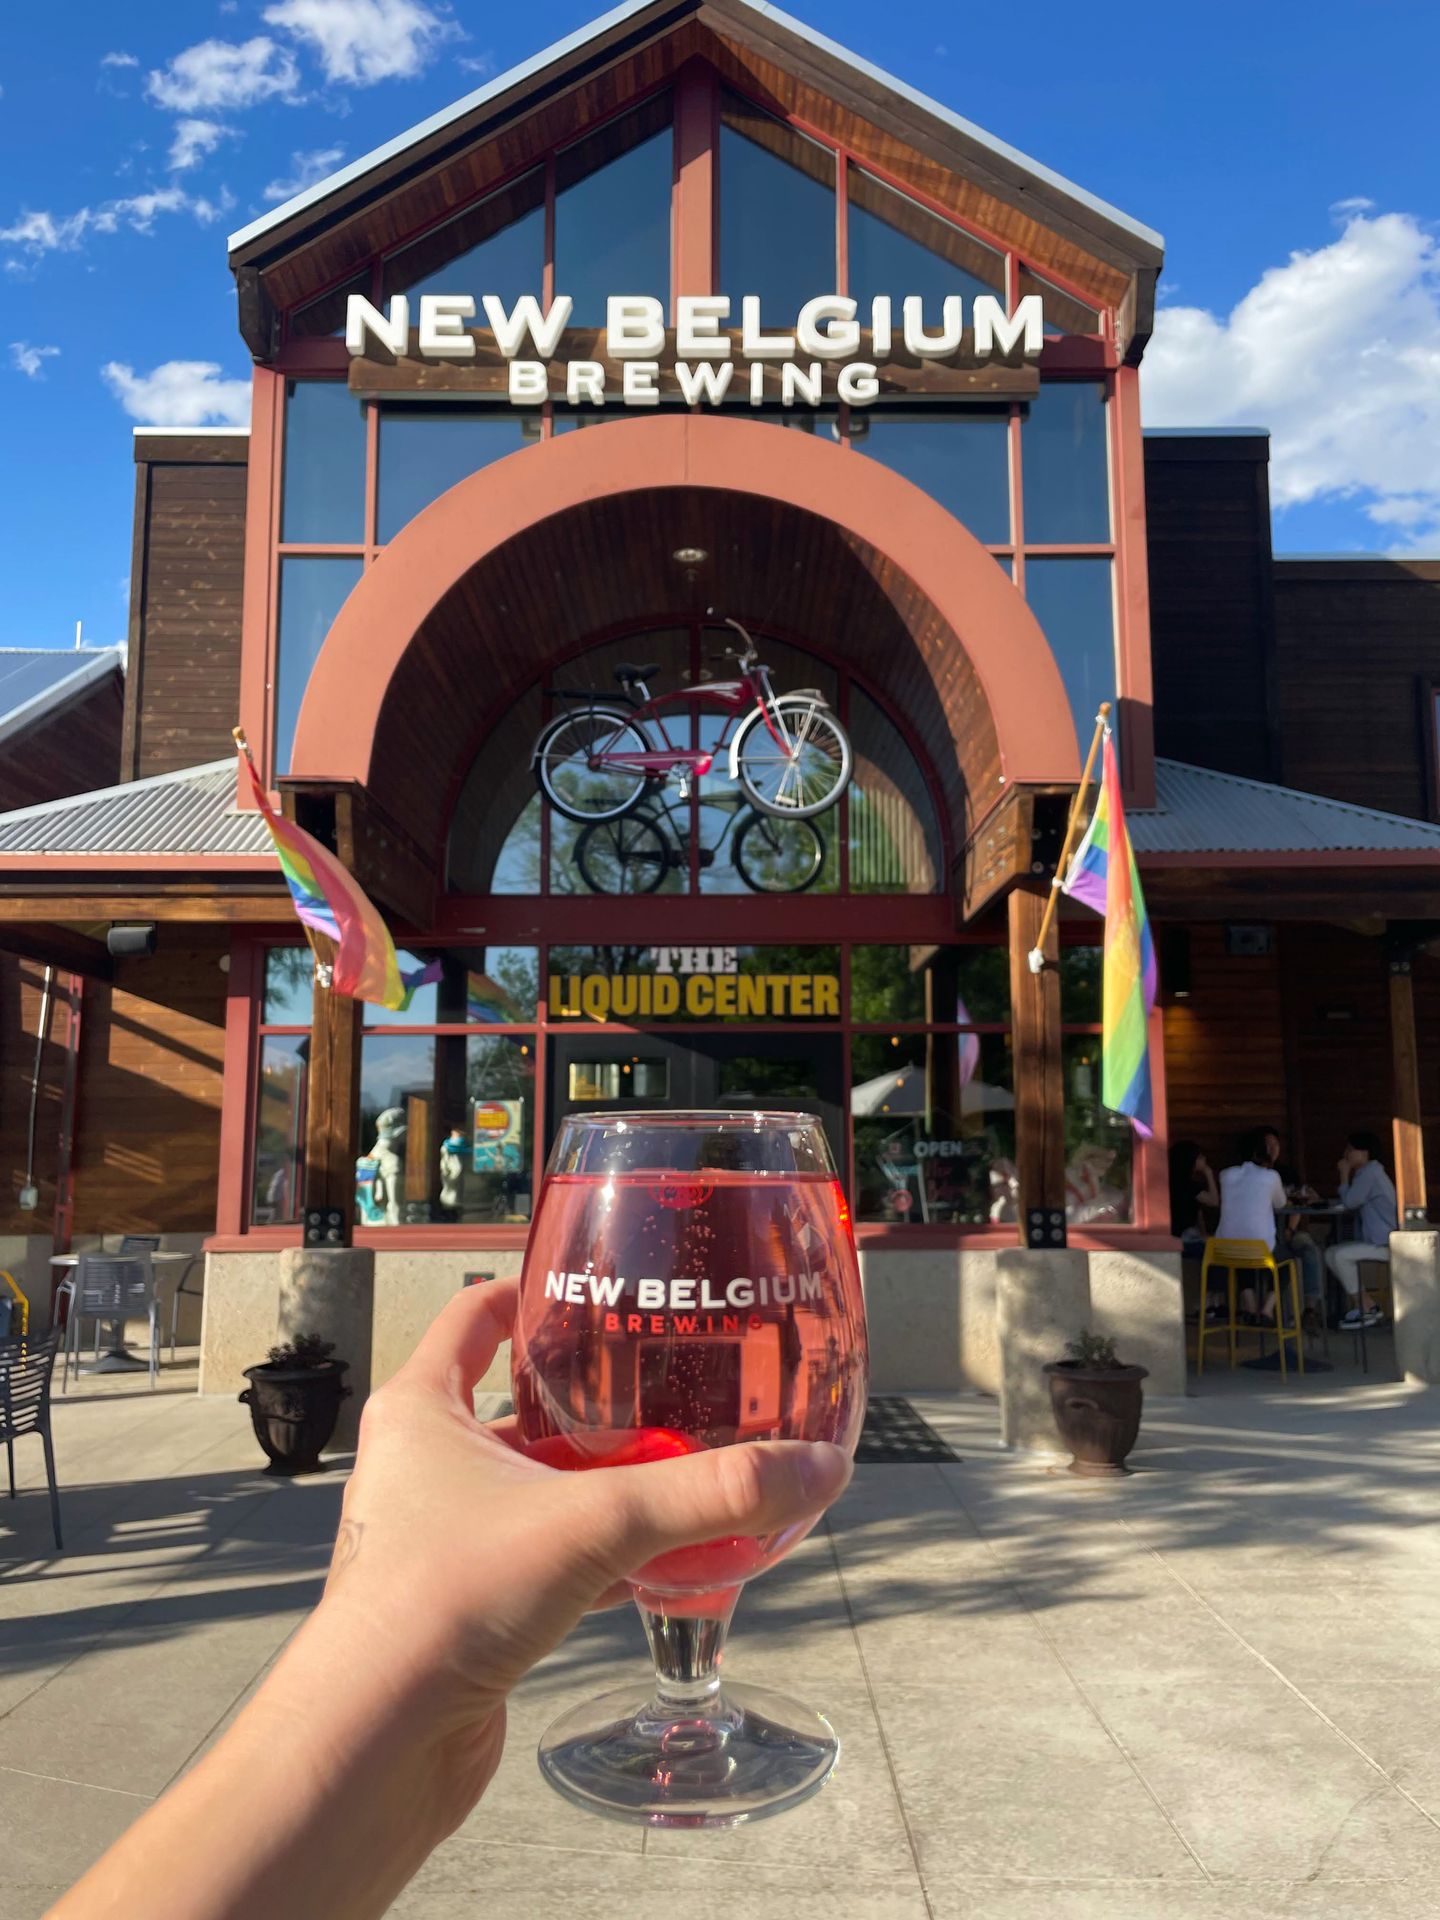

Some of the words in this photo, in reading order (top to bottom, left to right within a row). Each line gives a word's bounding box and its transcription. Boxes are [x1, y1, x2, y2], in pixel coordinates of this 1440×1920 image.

[345, 294, 573, 358] NEW
[607, 294, 1044, 359] BELGIUM
[508, 360, 881, 406] BREWING
[651, 946, 739, 974] THE
[549, 974, 681, 1021] LIQUID
[685, 974, 840, 1016] CENTER
[912, 1140, 962, 1158] OPEN
[544, 1270, 625, 1307] NEW
[636, 1271, 824, 1310] BELGIUM
[605, 1312, 763, 1335] BREWING
